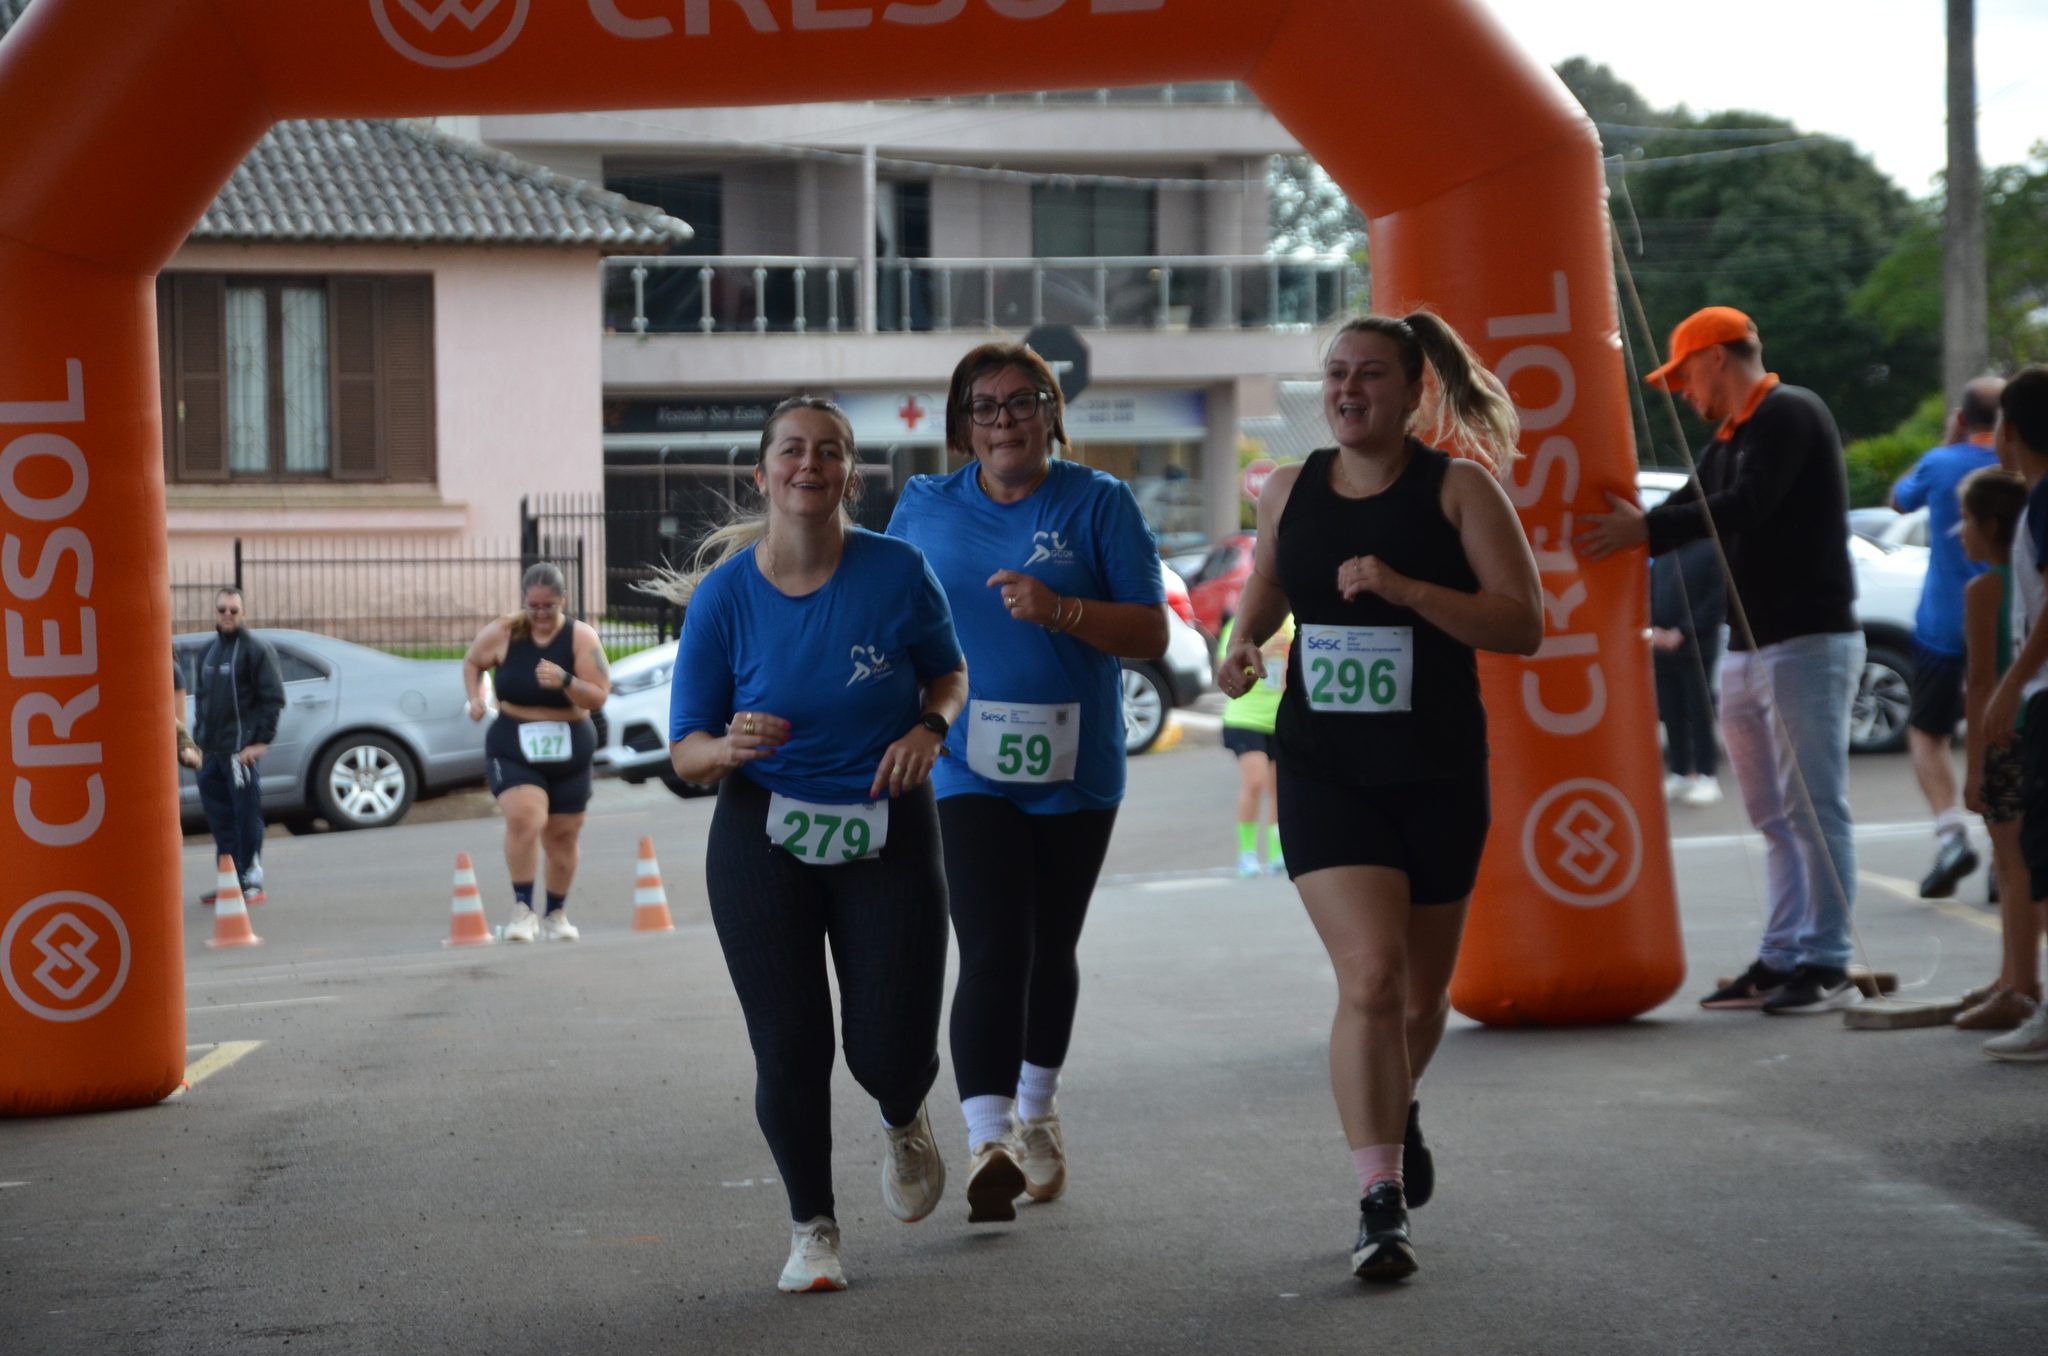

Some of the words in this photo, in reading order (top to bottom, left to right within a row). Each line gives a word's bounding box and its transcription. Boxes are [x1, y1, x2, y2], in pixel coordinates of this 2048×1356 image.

[0, 358, 106, 847] CRESOL
[1308, 636, 1341, 650] Sesc
[1311, 657, 1397, 705] 296
[528, 735, 564, 756] 127
[997, 733, 1051, 776] 59
[782, 810, 870, 860] 279
